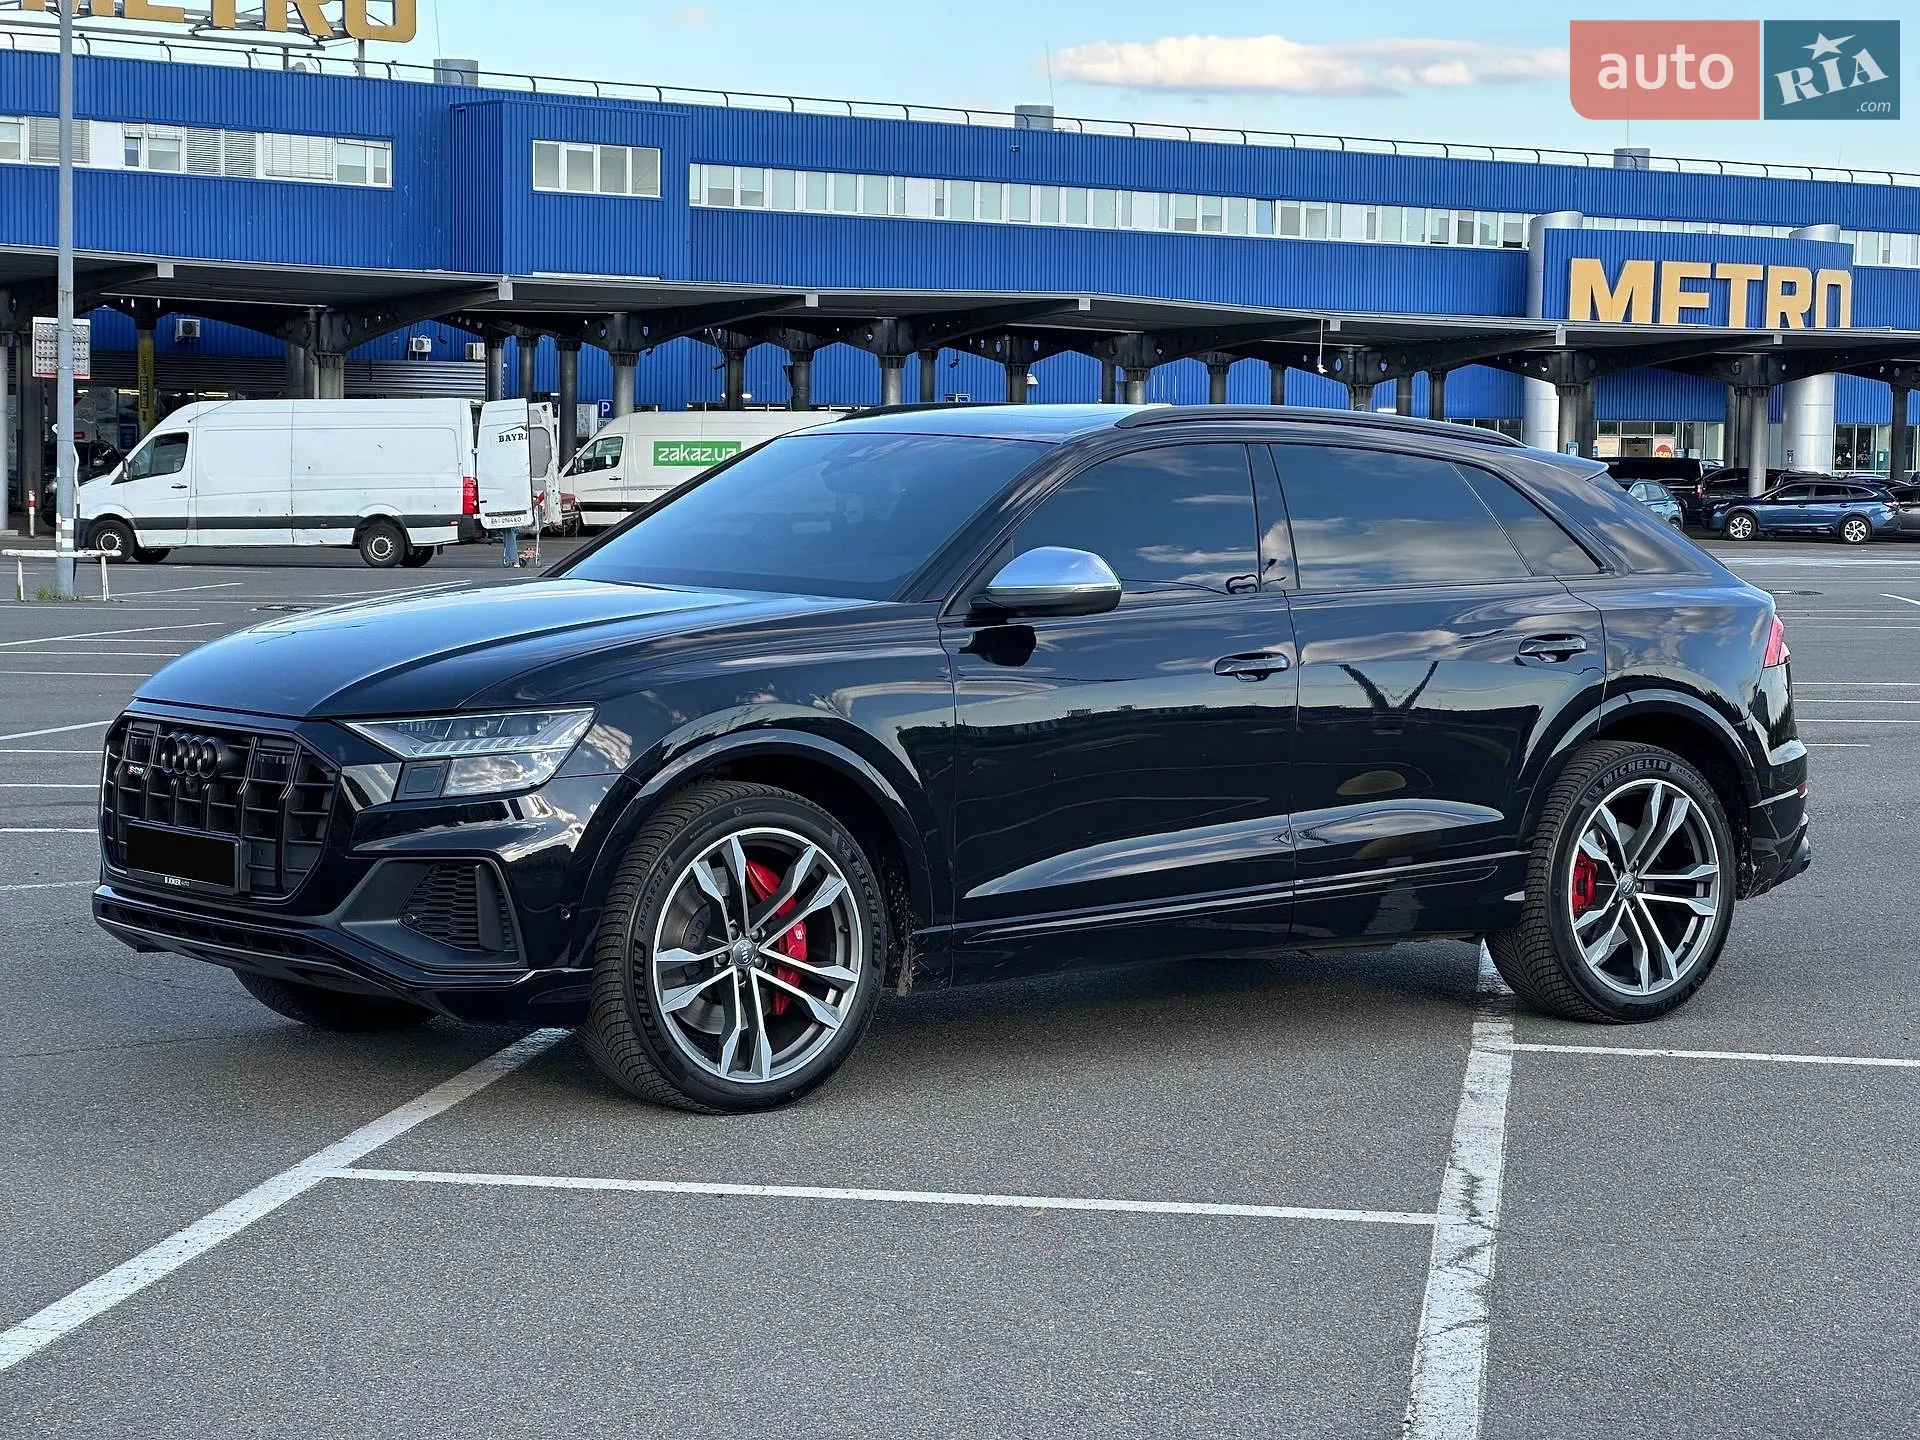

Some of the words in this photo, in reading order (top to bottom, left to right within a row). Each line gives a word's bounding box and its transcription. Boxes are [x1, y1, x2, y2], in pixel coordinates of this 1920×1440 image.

[1569, 257, 1852, 329] METRO
[601, 401, 611, 417] P
[1603, 759, 1669, 787] MICHELIN
[852, 859, 882, 963] MICHELIN
